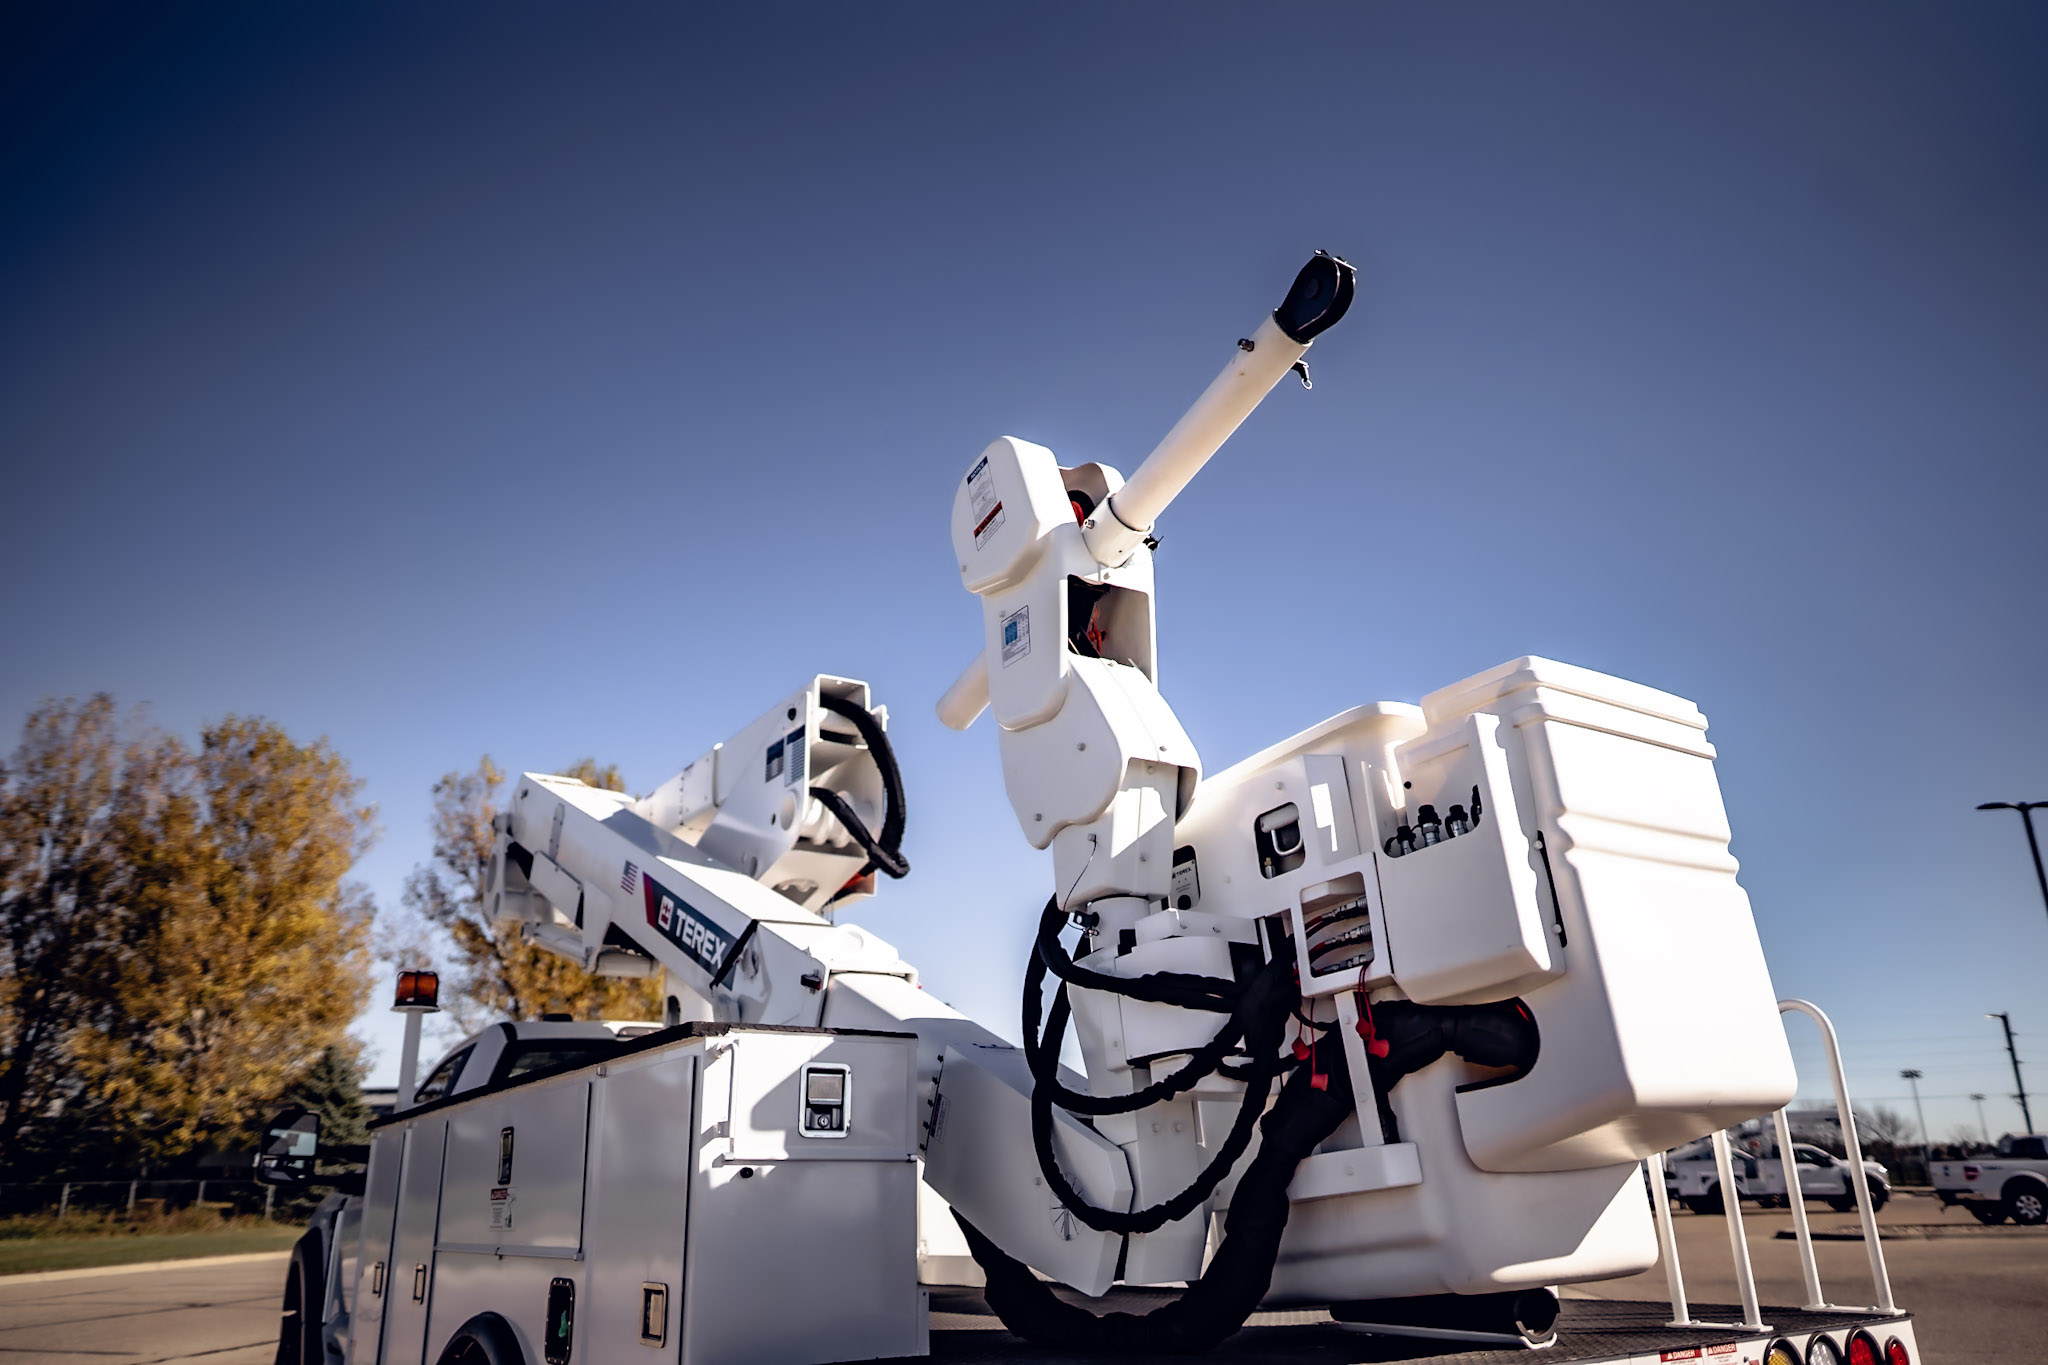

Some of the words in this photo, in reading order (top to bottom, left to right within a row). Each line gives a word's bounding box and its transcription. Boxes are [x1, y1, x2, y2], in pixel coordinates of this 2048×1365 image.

[675, 908, 727, 970] TEREX
[1713, 1344, 1735, 1353] DANGER
[1672, 1349, 1695, 1359] DANGER
